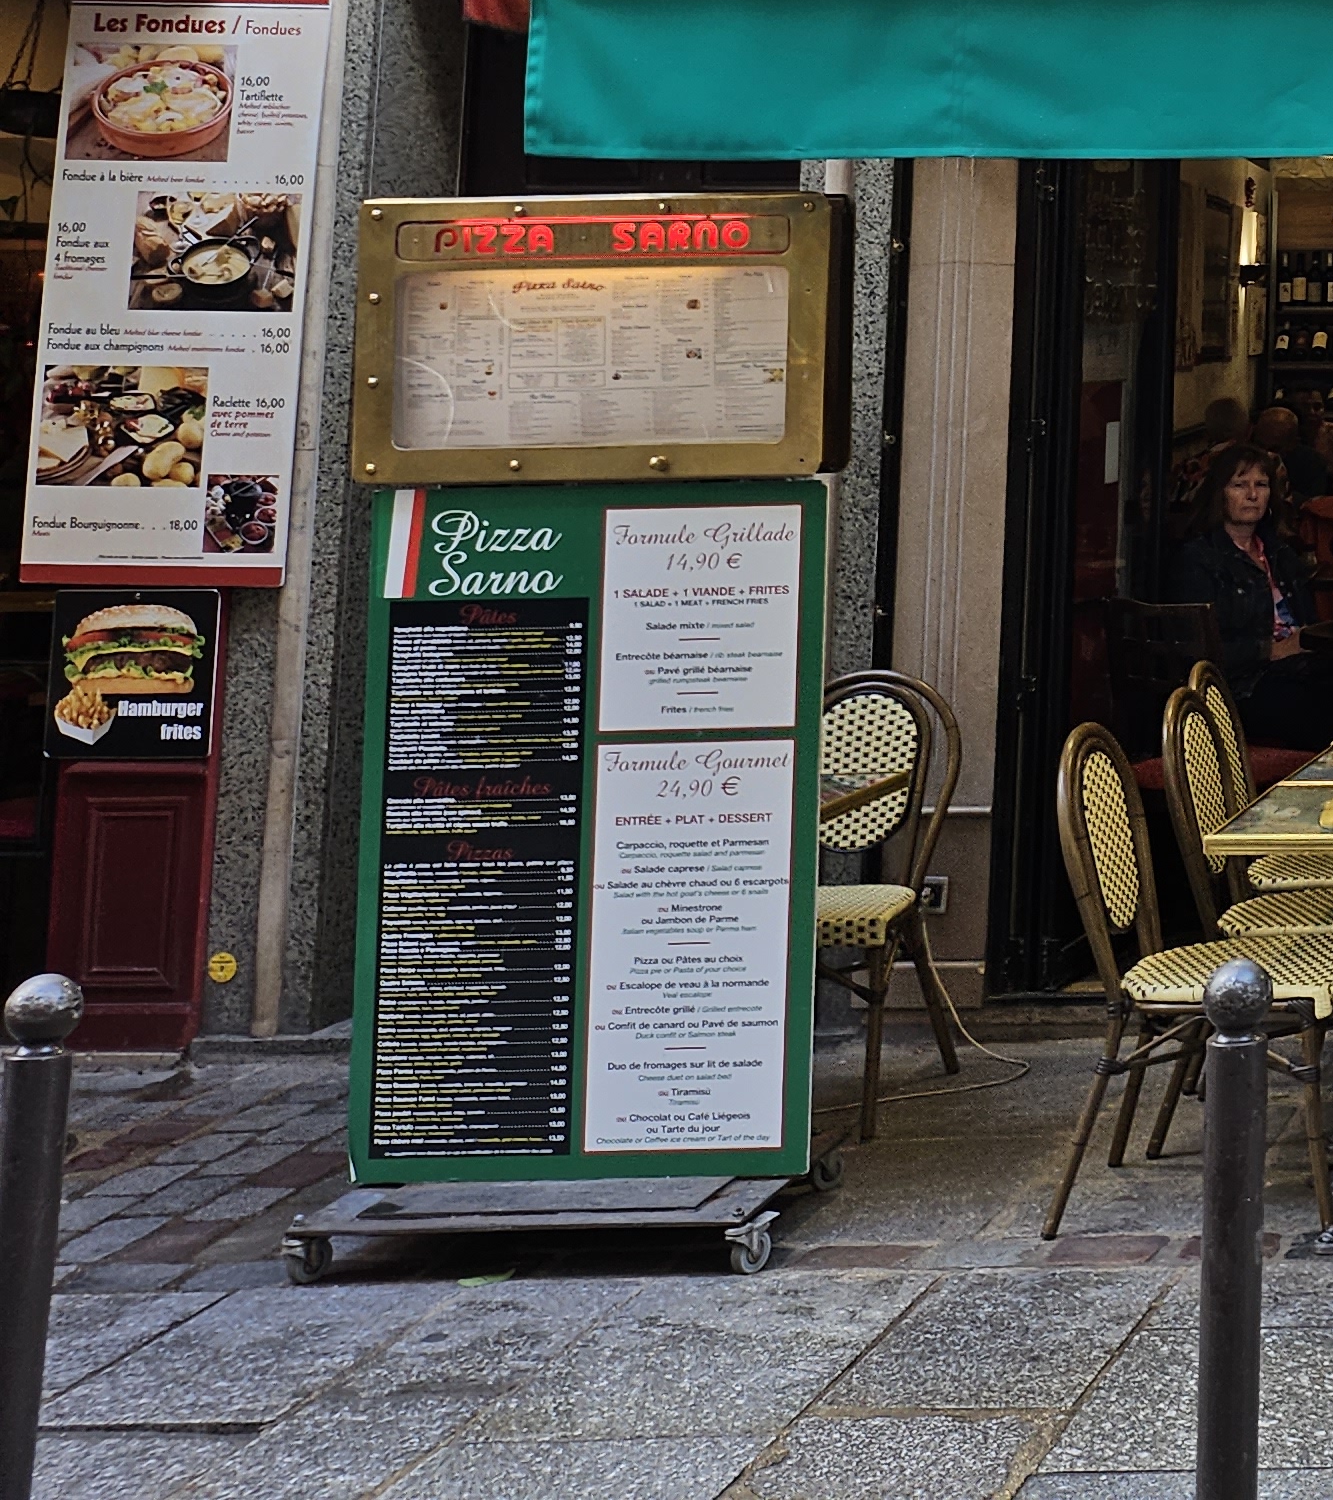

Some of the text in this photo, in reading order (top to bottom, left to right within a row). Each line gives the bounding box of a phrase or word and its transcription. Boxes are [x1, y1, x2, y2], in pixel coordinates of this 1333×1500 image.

[94, 13, 302, 36] Les Fondues Fondues
[241, 76, 270, 87] 16,00
[240, 90, 285, 102] Tartiflette
[62, 168, 96, 181] Fondue
[119, 169, 143, 182] bière
[275, 174, 304, 186] 16,00
[57, 222, 86, 233] 16,00
[56, 236, 90, 248] Fondue
[433, 219, 751, 255] PIZZA SARNO
[63, 251, 105, 264] fromages
[47, 322, 82, 335] Fondue
[99, 323, 120, 335] bleu
[261, 327, 291, 338] 16,00
[46, 337, 81, 350] Fondue
[103, 338, 164, 353] champignons
[260, 342, 290, 354] 16,00
[212, 396, 286, 409] Raclette 16,00
[211, 411, 275, 421] avec pommes
[211, 419, 249, 429] de terre
[32, 516, 67, 529] Fondue
[169, 519, 198, 531] 18,00
[431, 509, 563, 555] Pizza
[613, 522, 798, 550] Formule Grillade
[666, 552, 720, 572] 14,90
[428, 550, 564, 596] Sarno
[622, 587, 669, 599] SALADE
[691, 586, 735, 596] VIANDE
[748, 584, 789, 595] FRITES
[746, 597, 768, 605] FRIES
[645, 621, 705, 630] Salade mixte
[657, 666, 680, 675] Pavé
[117, 700, 204, 717] Hamburger
[661, 705, 687, 714] Frites
[160, 723, 202, 741] frites
[604, 749, 789, 776] Formule Gourmet
[656, 776, 741, 798] 24,90 €
[675, 814, 705, 825] PLAT
[718, 812, 772, 823] DESSERT
[617, 840, 666, 850] Carpaccio,
[668, 840, 708, 849] roquette
[722, 838, 769, 847] Parmesan
[634, 865, 665, 874] Salade
[607, 880, 638, 889] Salade
[688, 878, 717, 887] chaud
[742, 877, 789, 887] escargots
[671, 904, 722, 912] Minestrone
[709, 914, 739, 923] Parme
[634, 956, 658, 965] Pizza
[675, 955, 701, 964] Pâtes
[619, 981, 662, 991] Escalope
[678, 981, 700, 989] veau
[722, 978, 769, 987] normande
[652, 1020, 685, 1029] canard
[701, 1019, 724, 1028] Pavé
[741, 1019, 778, 1027] saumon
[607, 1062, 626, 1071] Duo
[643, 1061, 687, 1071] fromages
[707, 1059, 716, 1068] lit
[732, 1059, 762, 1067] salade
[629, 1113, 671, 1122] Chocolat
[687, 1112, 709, 1121] Café
[661, 1124, 685, 1134] Tarte
[701, 1124, 720, 1135] jour
